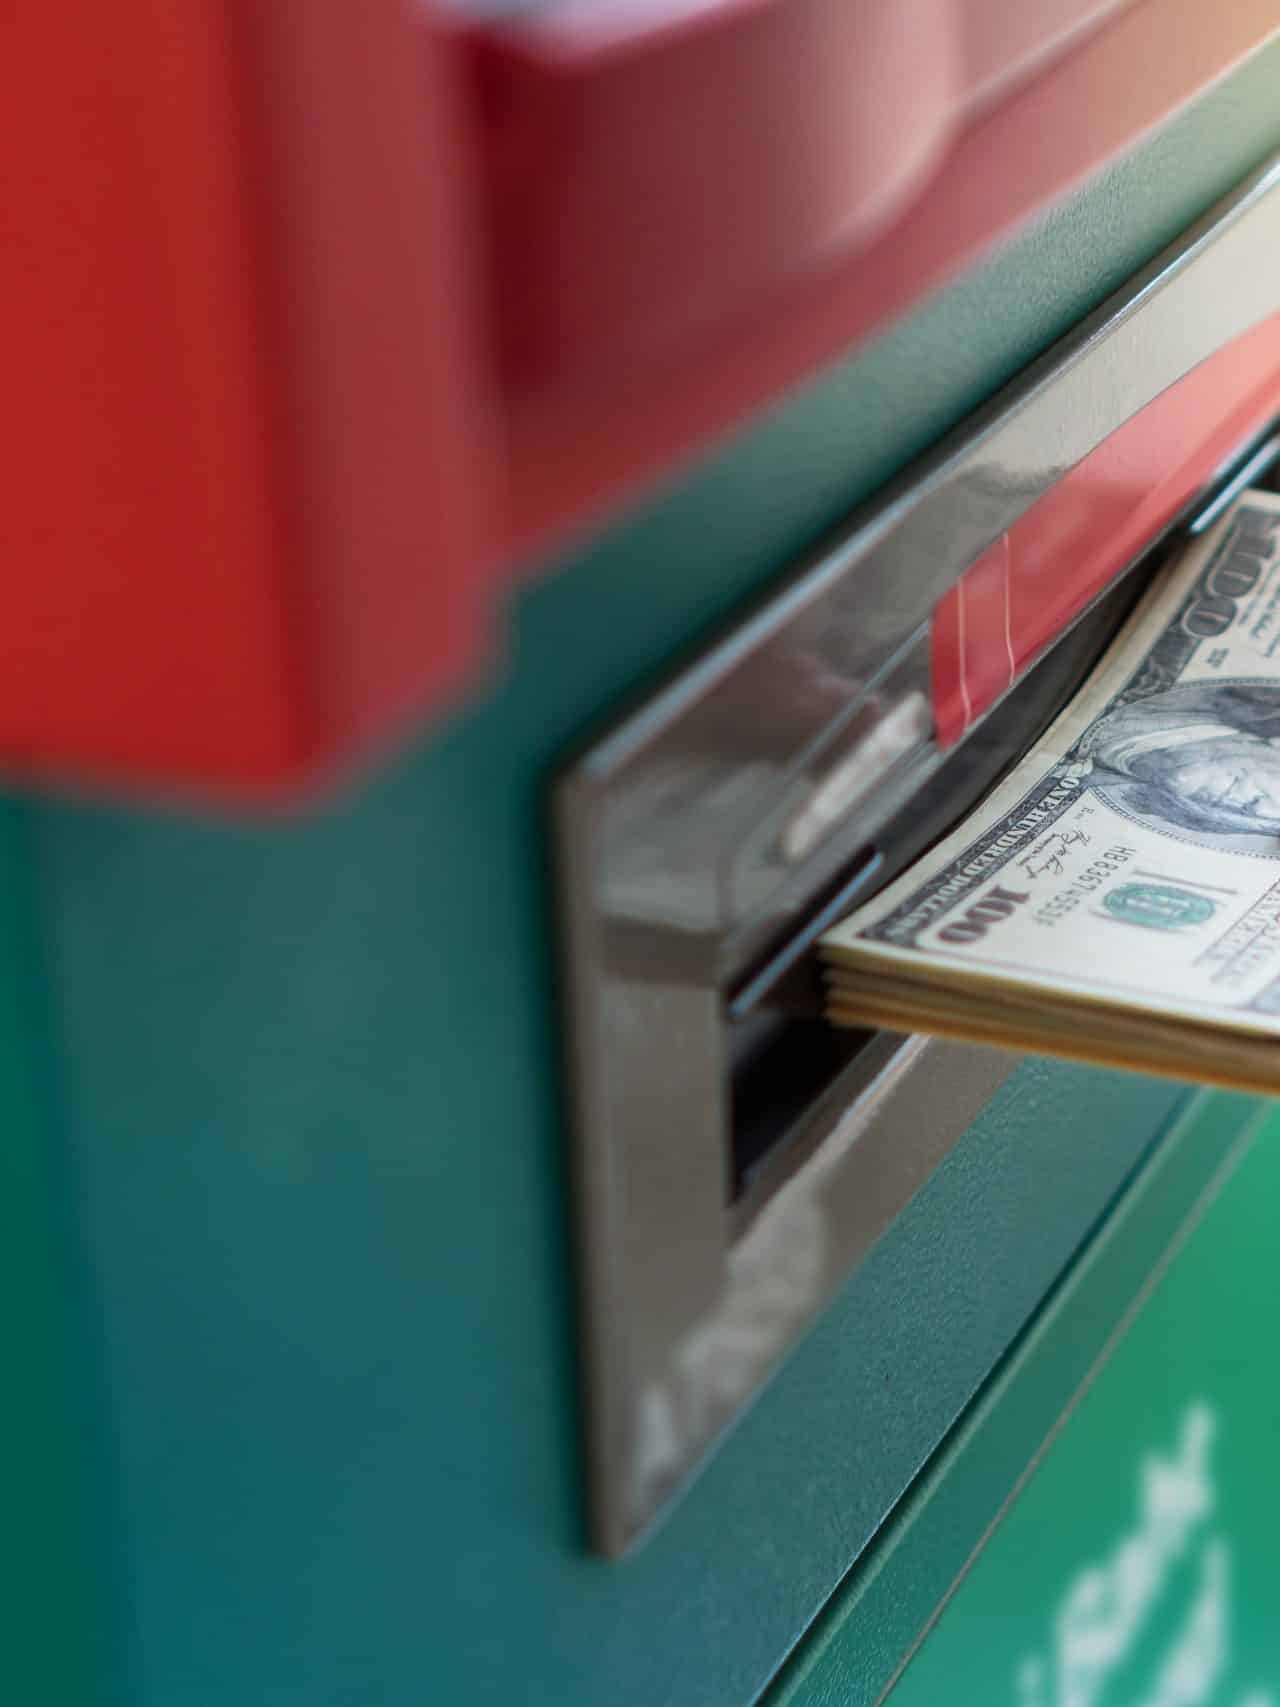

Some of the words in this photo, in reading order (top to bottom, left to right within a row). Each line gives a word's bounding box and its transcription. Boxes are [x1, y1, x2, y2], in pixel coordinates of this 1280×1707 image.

[1181, 522, 1276, 638] 100
[1038, 775, 1080, 813] ONE
[936, 884, 1030, 945] 100
